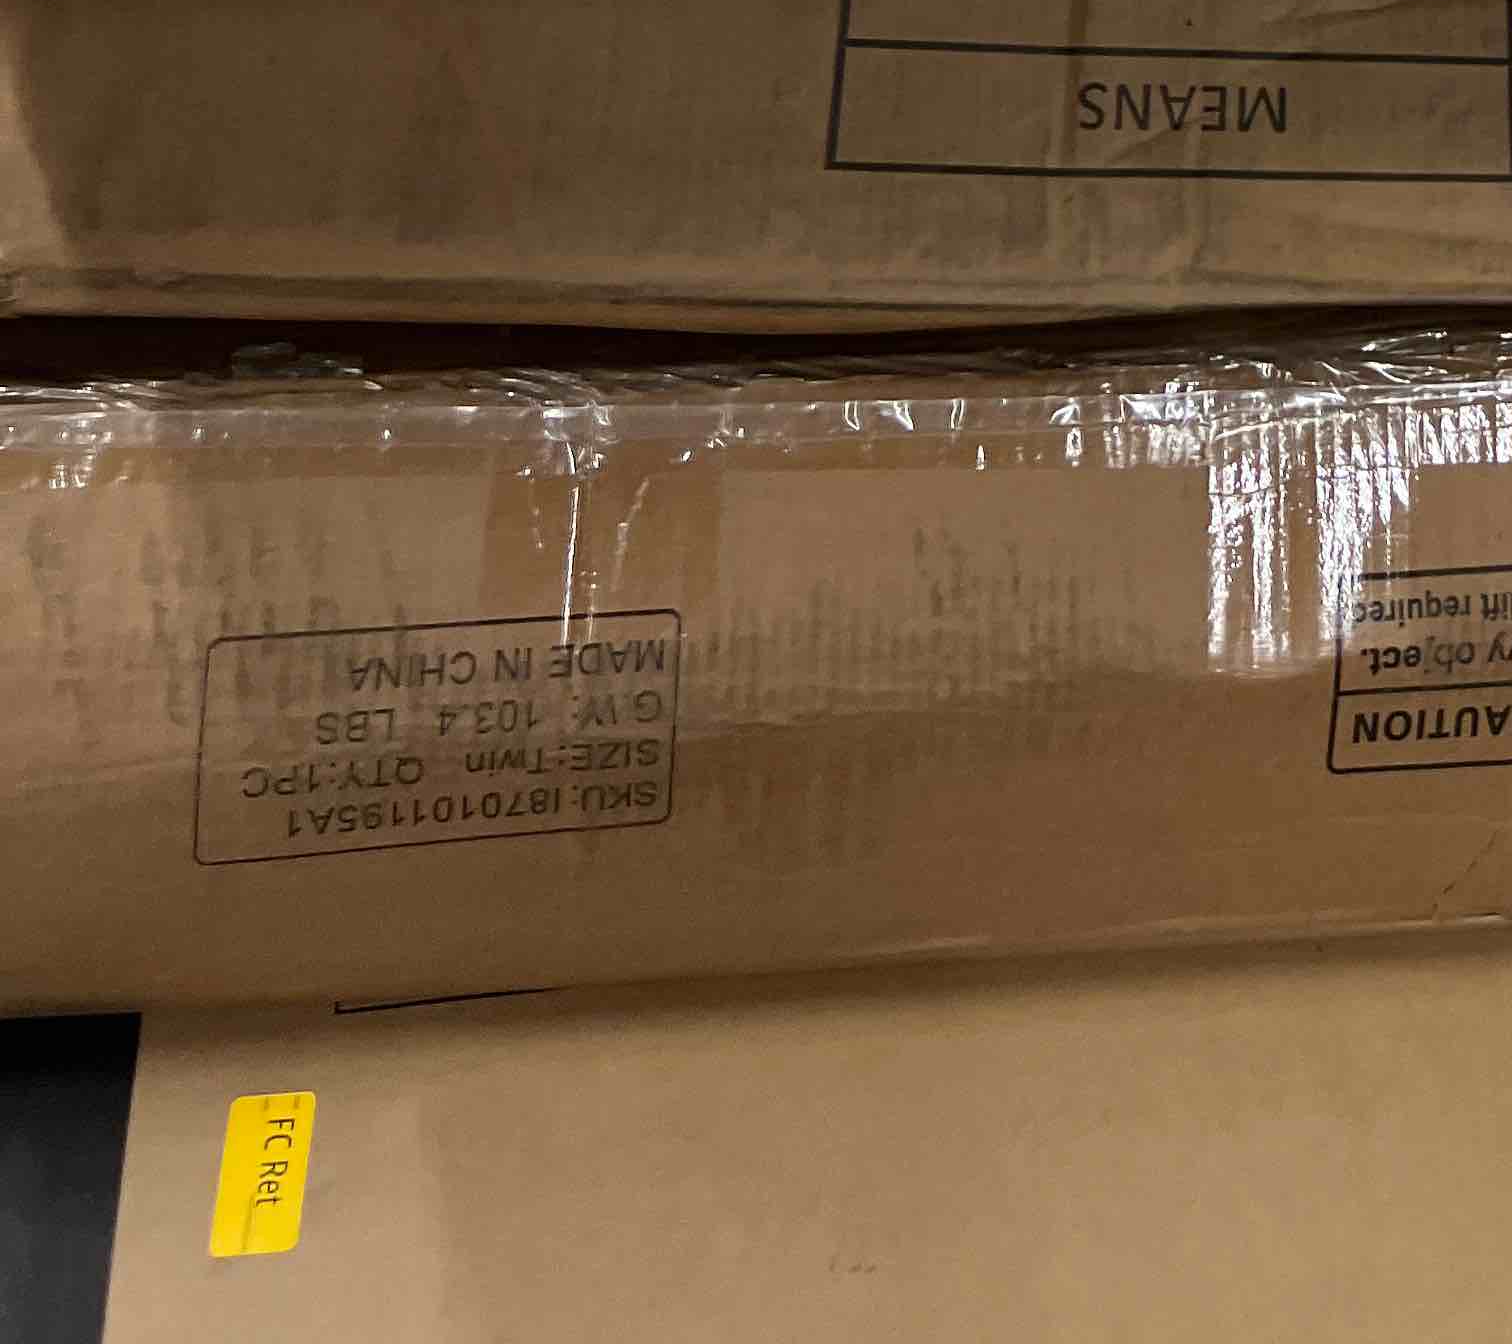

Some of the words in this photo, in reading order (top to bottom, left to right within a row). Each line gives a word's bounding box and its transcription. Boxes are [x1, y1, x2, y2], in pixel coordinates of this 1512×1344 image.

[1077, 80, 1289, 136] MEANS
[347, 650, 478, 693] CHINA
[494, 646, 532, 681] IN
[549, 639, 667, 678] MADE
[1359, 637, 1475, 676] object.
[315, 706, 396, 745] LBS
[240, 755, 426, 800] QTY:1PC
[263, 1117, 296, 1152] FC
[255, 1159, 290, 1208] Ret
